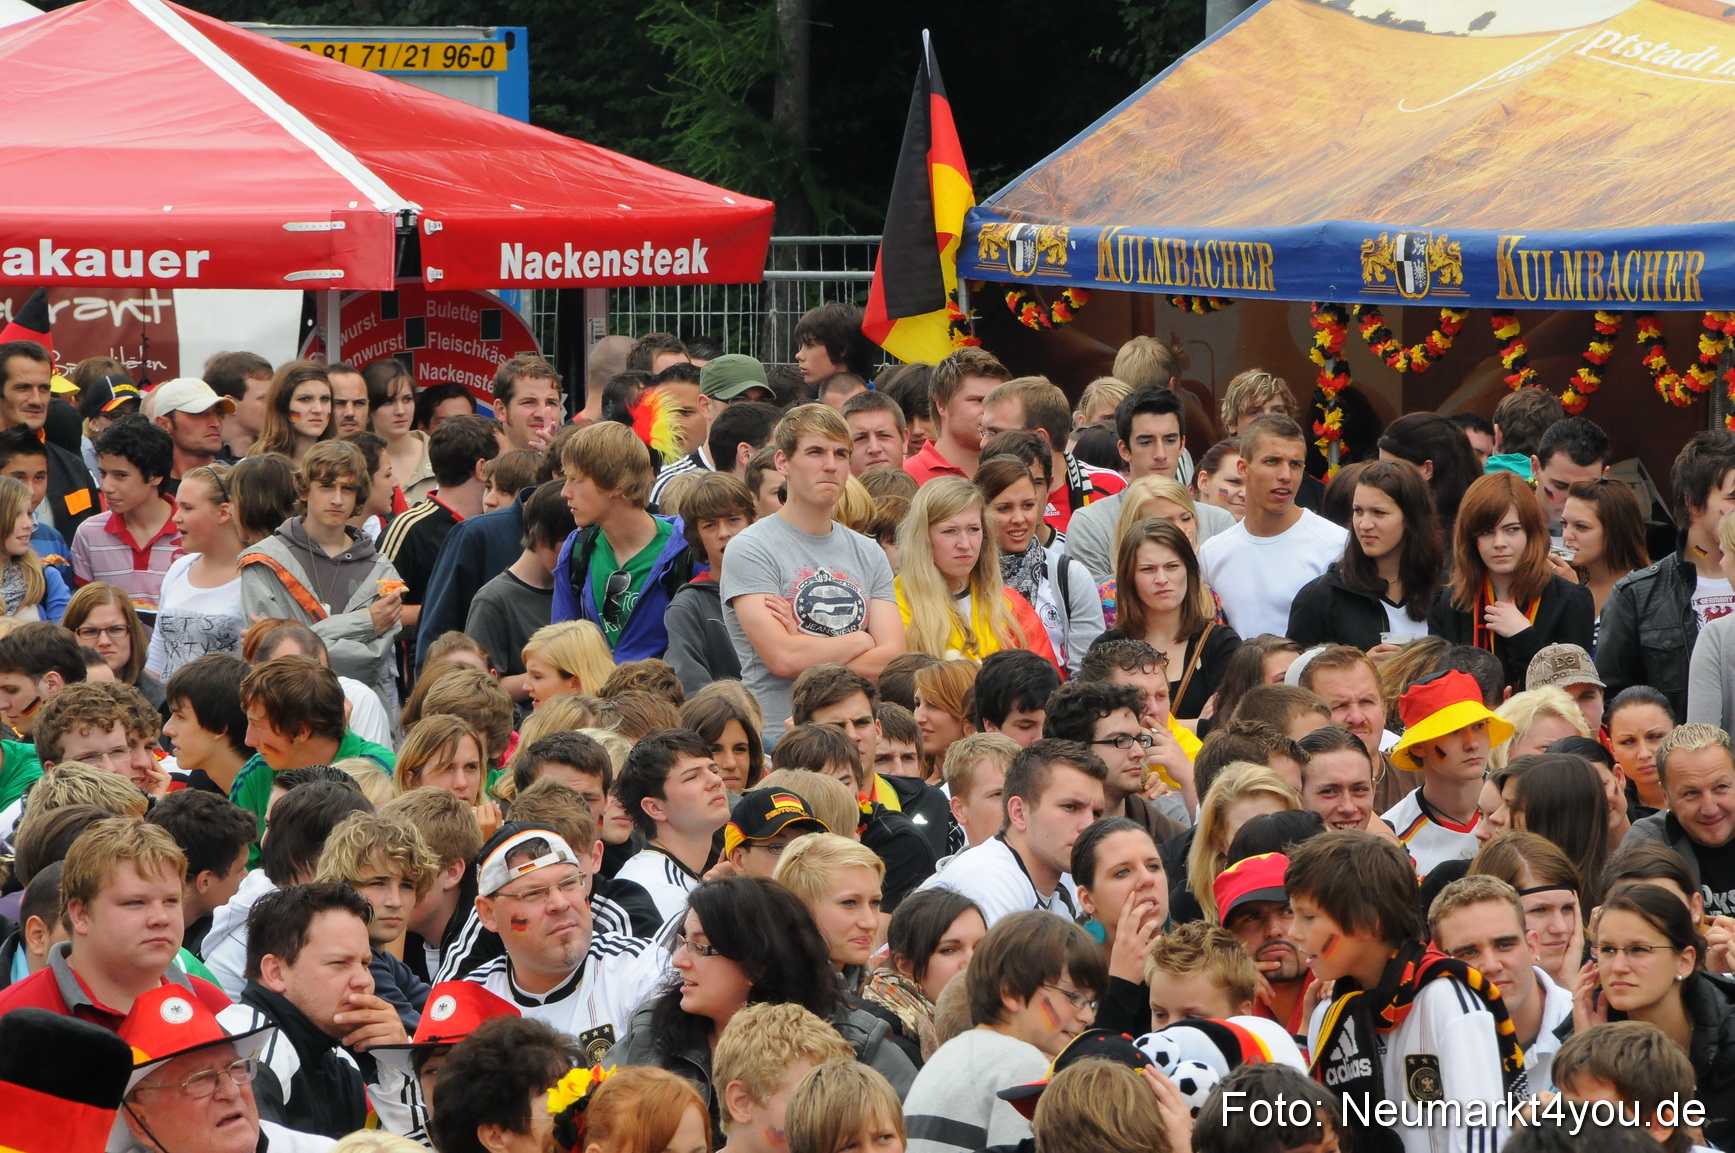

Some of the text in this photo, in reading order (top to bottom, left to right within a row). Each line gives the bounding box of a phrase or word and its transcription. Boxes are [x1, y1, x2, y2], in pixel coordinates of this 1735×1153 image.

[361, 43, 431, 68] 71/21
[442, 45, 495, 68] 96-0
[1, 238, 210, 278] akauer
[500, 238, 709, 280] Nackensteak
[1095, 226, 1276, 291] KULMBACHER
[1496, 235, 1705, 302] KULMBACHER
[341, 311, 378, 347] wurst
[426, 300, 479, 324] Bulette
[428, 331, 507, 366] Fleischkäs
[420, 362, 494, 394] Nackenste
